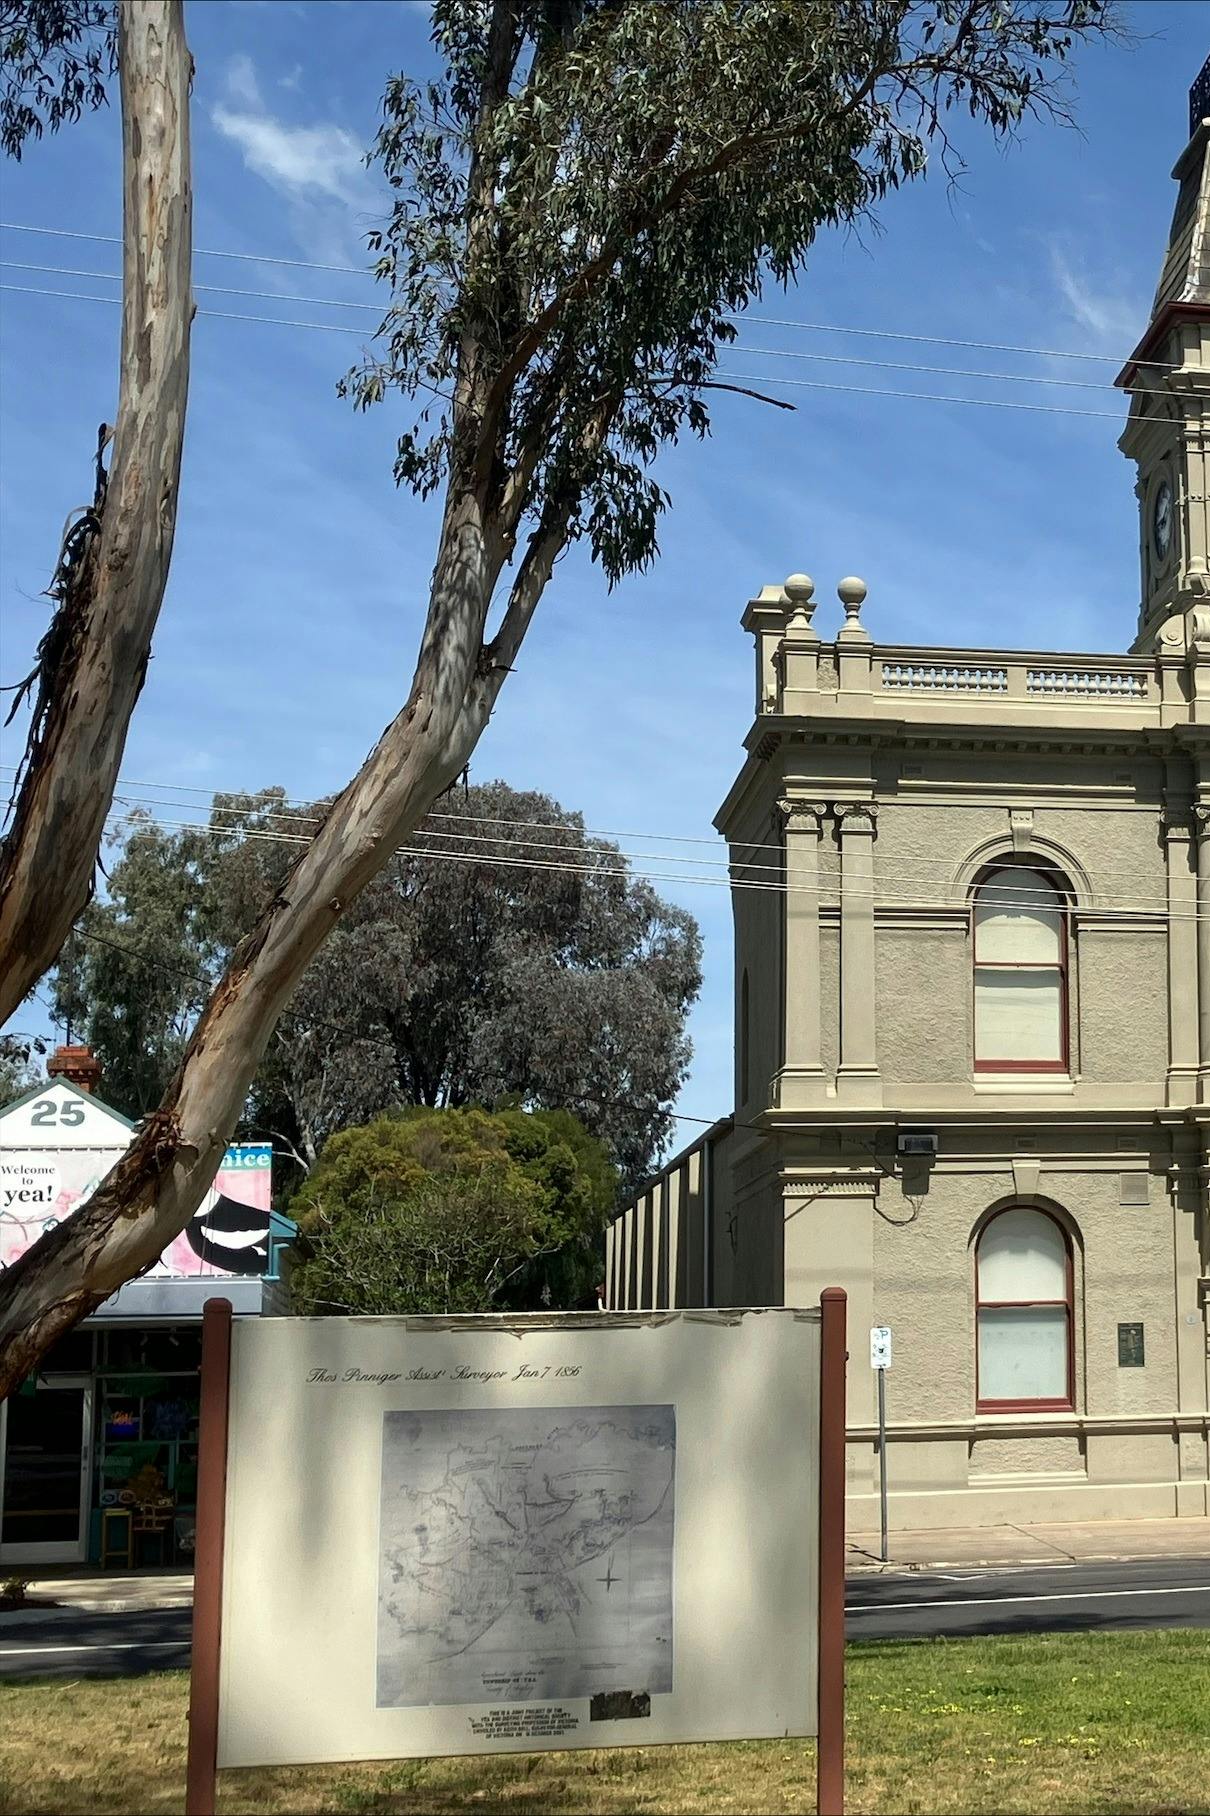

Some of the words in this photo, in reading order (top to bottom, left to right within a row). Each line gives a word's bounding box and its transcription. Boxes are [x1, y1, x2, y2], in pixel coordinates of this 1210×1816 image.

[31, 1100, 85, 1126] 25
[1, 1164, 56, 1175] Welcome
[22, 1177, 33, 1185] to
[4, 1185, 52, 1207] yea!
[306, 1367, 338, 1382] Thos
[450, 1365, 507, 1383] Surveyor
[512, 1364, 539, 1381] Jan
